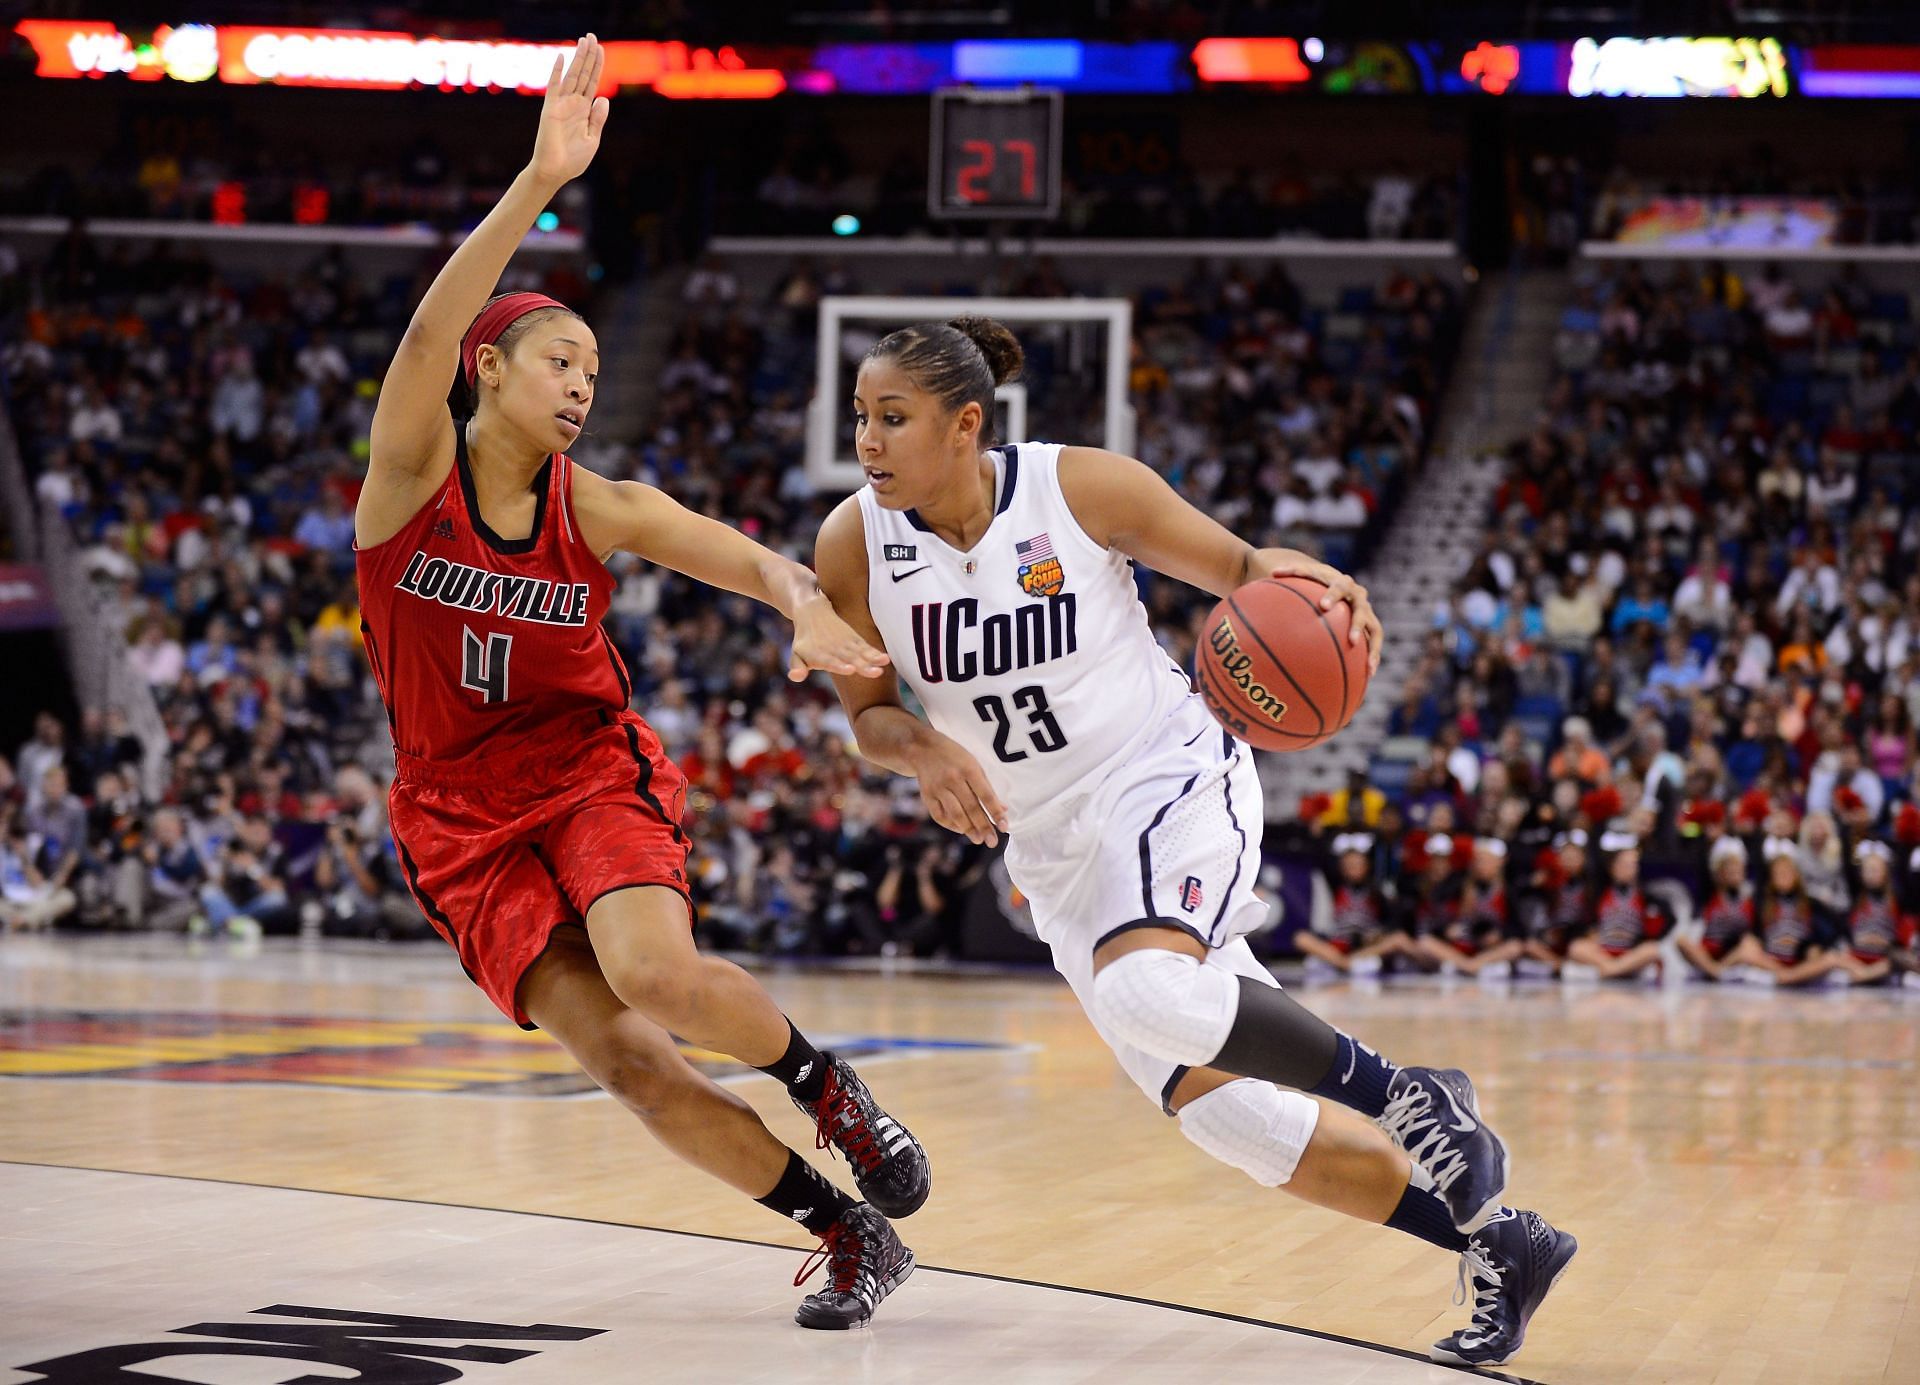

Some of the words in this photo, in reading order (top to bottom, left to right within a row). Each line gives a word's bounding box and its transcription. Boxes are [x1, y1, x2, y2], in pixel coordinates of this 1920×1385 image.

[957, 139, 1036, 203] 27
[395, 550, 590, 627] LOUISVILLE
[890, 547, 909, 558] SH
[1023, 568, 1063, 593] FOUR
[1031, 559, 1060, 576] FINAL
[460, 624, 513, 704] 4
[911, 593, 1077, 684] UConn
[1209, 615, 1289, 723] Wilson
[972, 685, 1069, 763] 23
